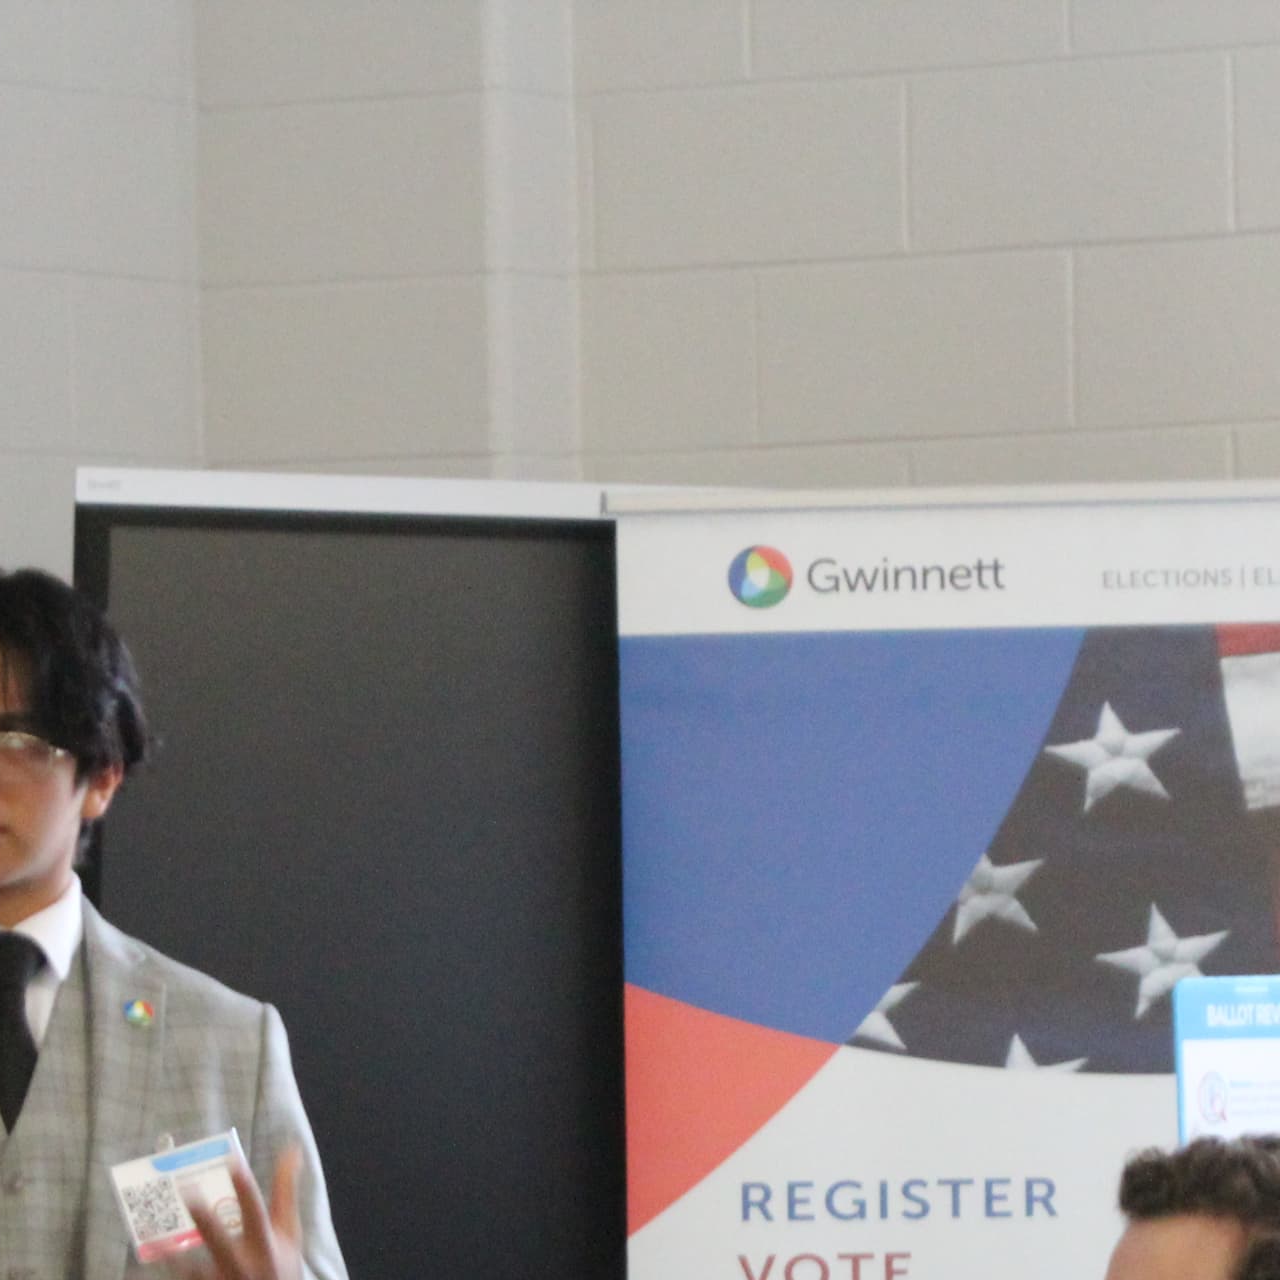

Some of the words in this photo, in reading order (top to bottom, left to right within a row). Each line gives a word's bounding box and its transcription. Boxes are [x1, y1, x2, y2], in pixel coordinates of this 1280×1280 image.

[807, 555, 1006, 596] Gwinnett
[1101, 567, 1233, 590] ELECTIONS
[1206, 1004, 1254, 1027] BALLOT
[741, 1177, 1058, 1222] REGISTER
